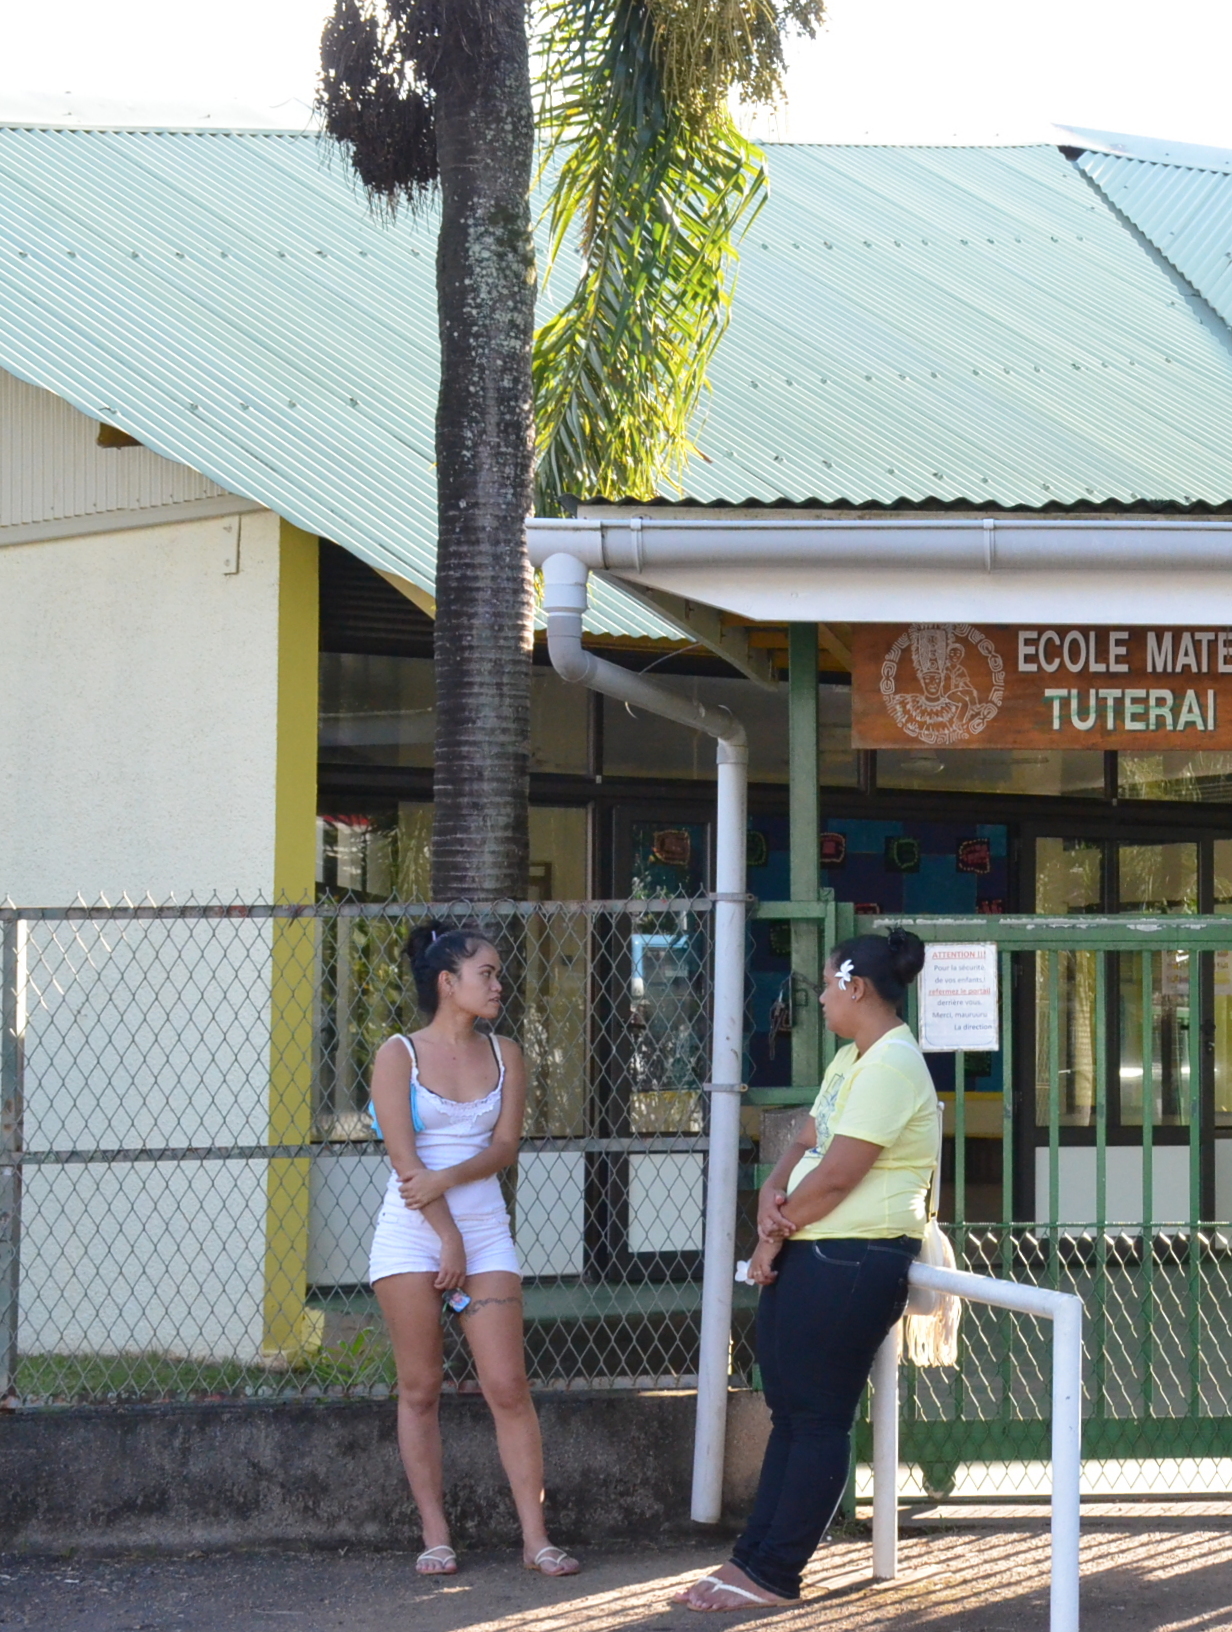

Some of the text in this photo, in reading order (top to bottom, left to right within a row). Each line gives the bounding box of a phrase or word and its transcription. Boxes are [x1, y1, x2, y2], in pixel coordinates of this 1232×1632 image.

[1018, 630, 1130, 673] ECOLE
[1045, 689, 1215, 731] TUTERAI
[932, 951, 975, 959] ATTENTION
[968, 988, 990, 996] portail
